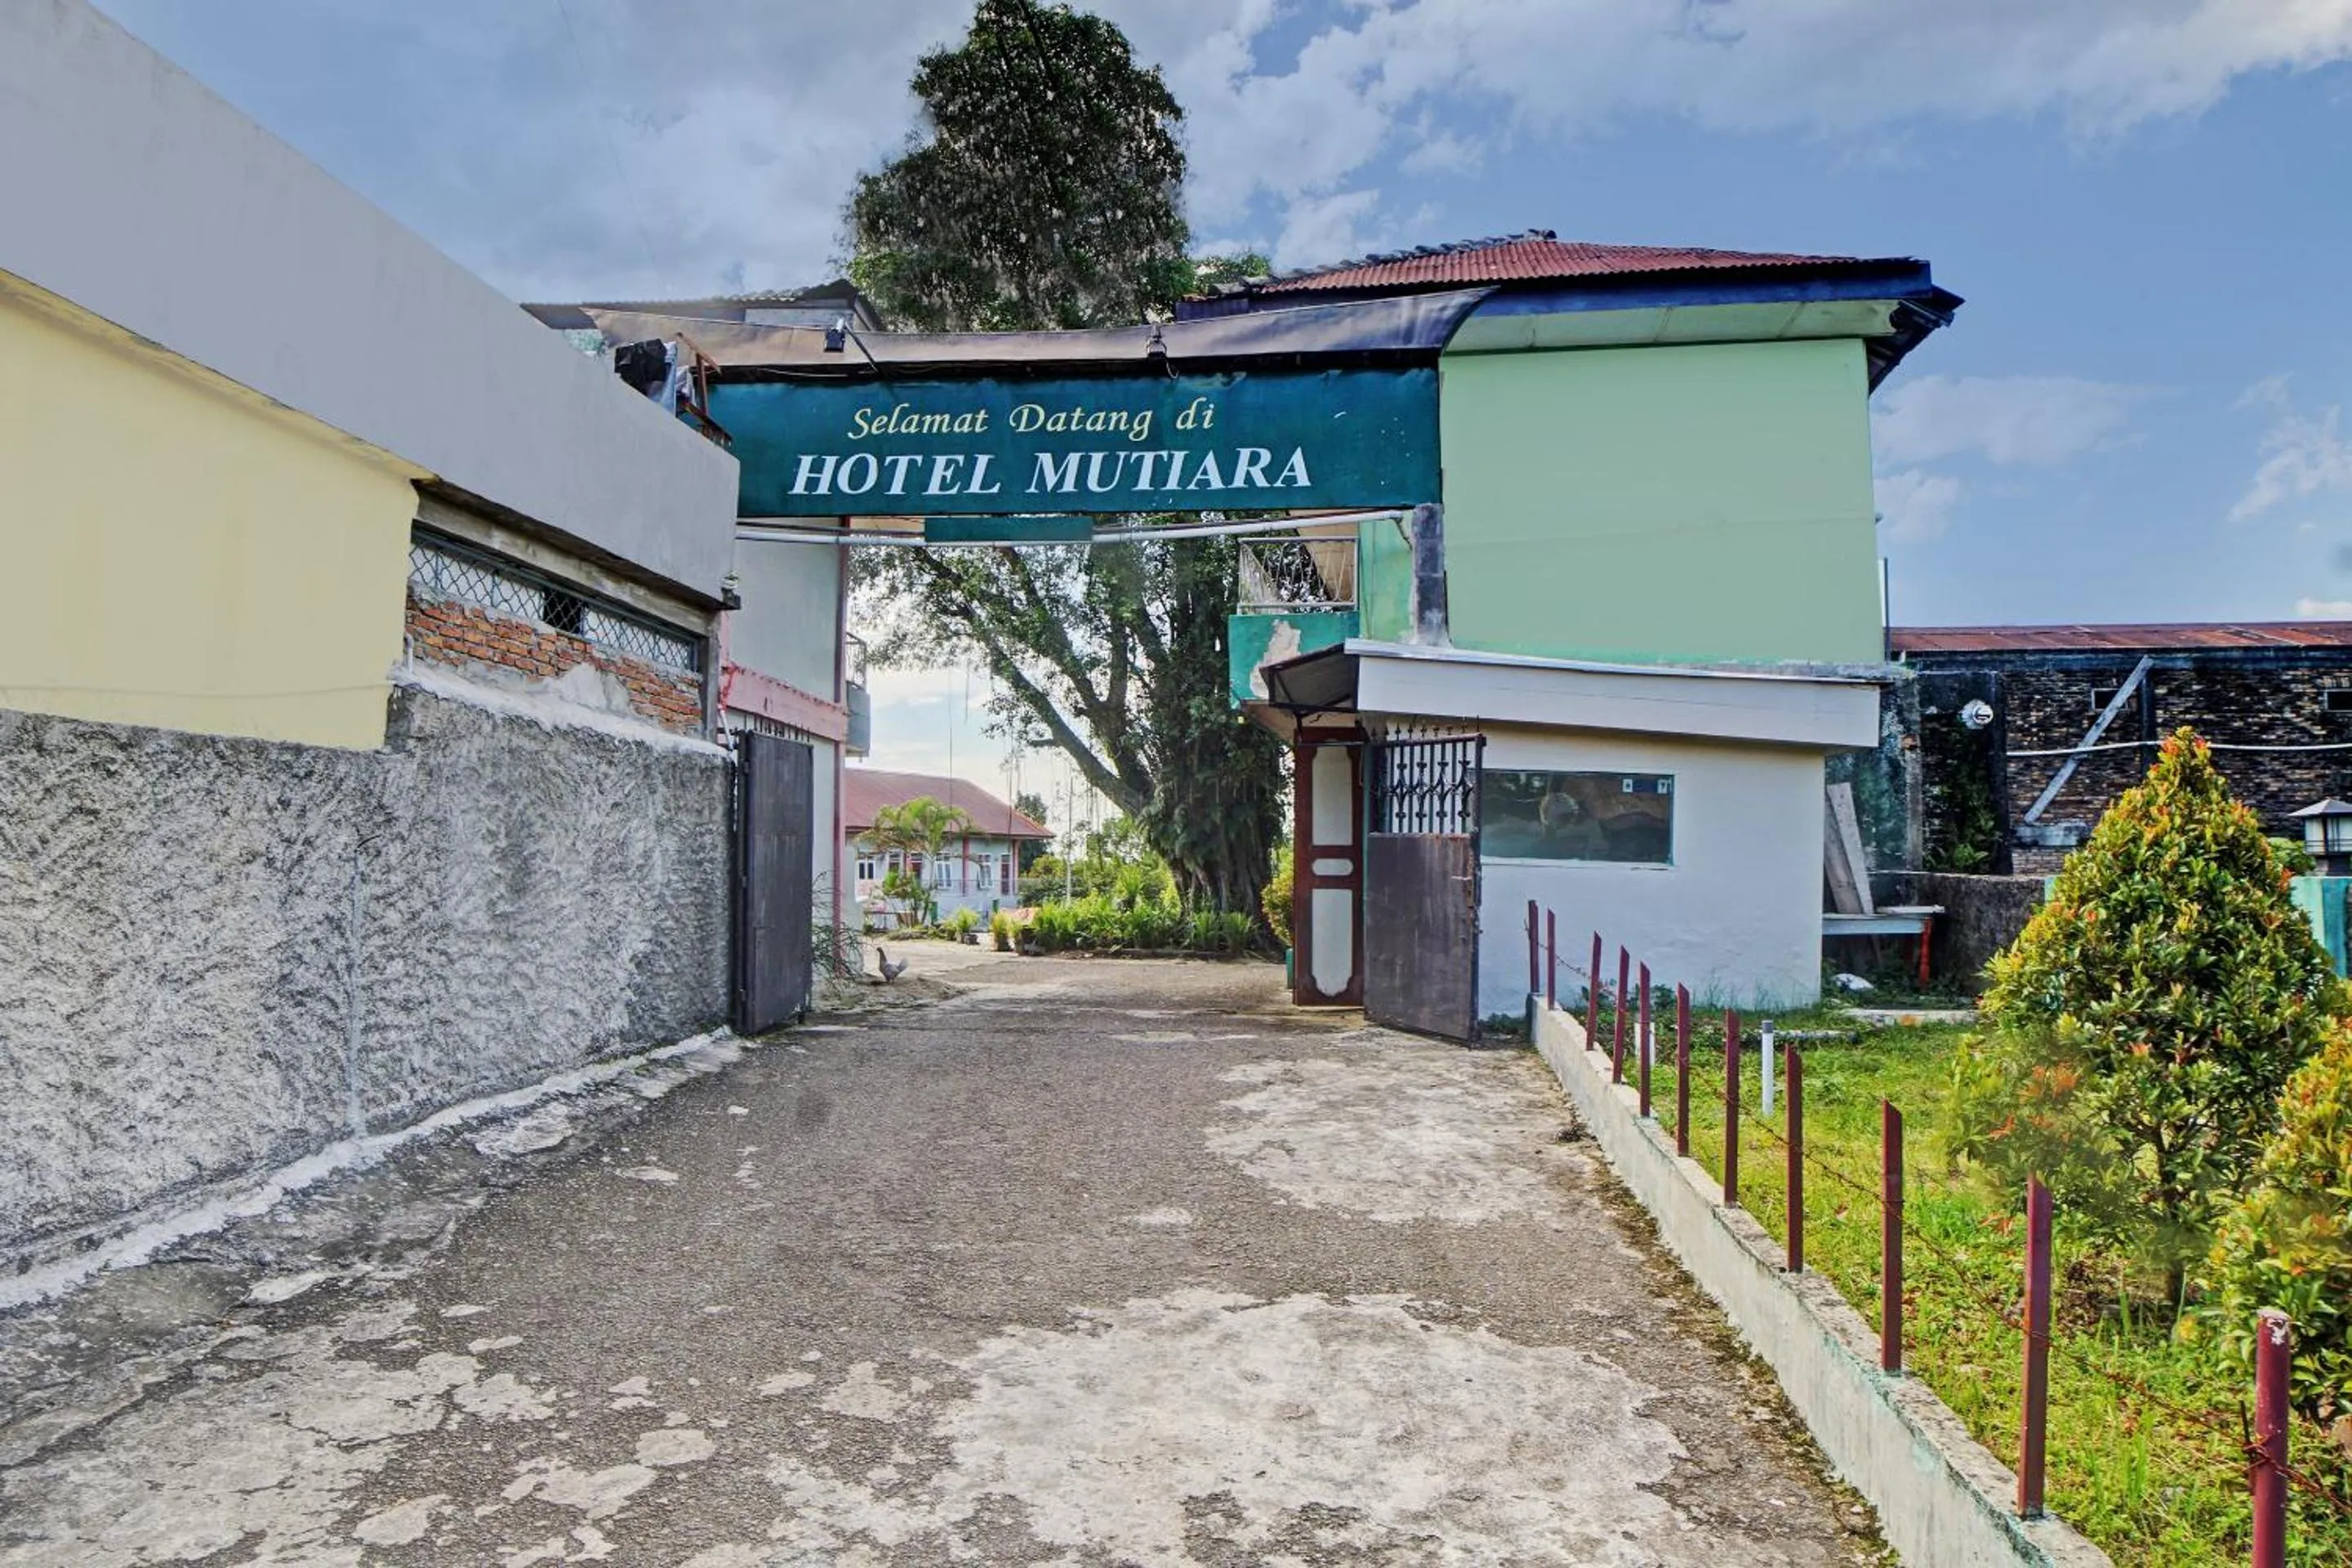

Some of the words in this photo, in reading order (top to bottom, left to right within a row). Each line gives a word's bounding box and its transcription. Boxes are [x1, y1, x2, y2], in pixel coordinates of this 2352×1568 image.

[847, 403, 989, 440] Selamat
[1009, 403, 1153, 442] Datang
[1176, 396, 1214, 430] di
[787, 452, 1002, 496] HOTEL
[1026, 446, 1312, 494] MUTIARA
